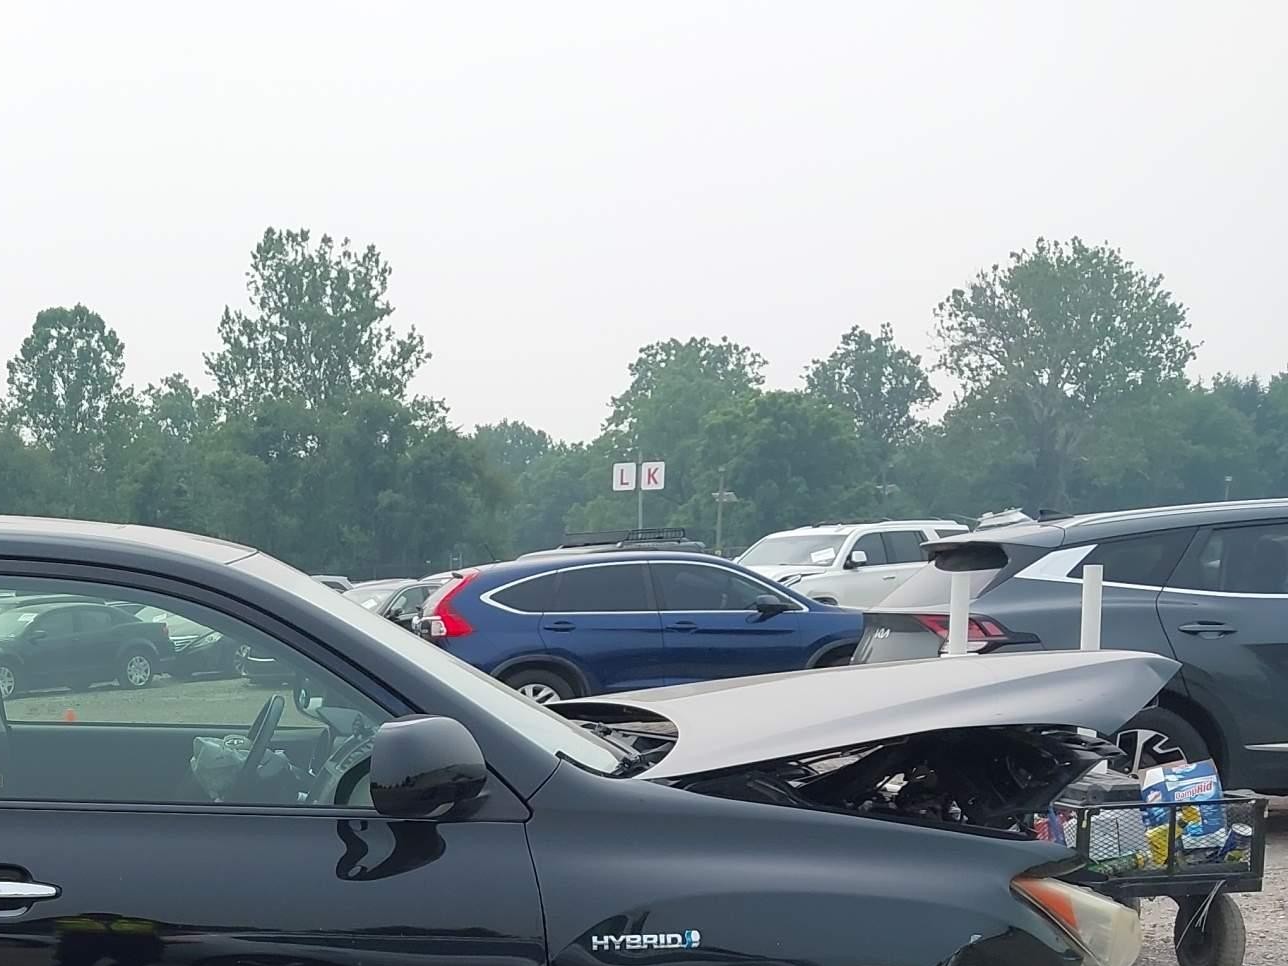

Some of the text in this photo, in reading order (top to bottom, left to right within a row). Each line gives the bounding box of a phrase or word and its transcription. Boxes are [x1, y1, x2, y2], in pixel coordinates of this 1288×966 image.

[620, 468, 629, 486] L
[648, 467, 659, 485] K
[1175, 781, 1213, 801] DampRid
[592, 933, 683, 951] HYBRID
